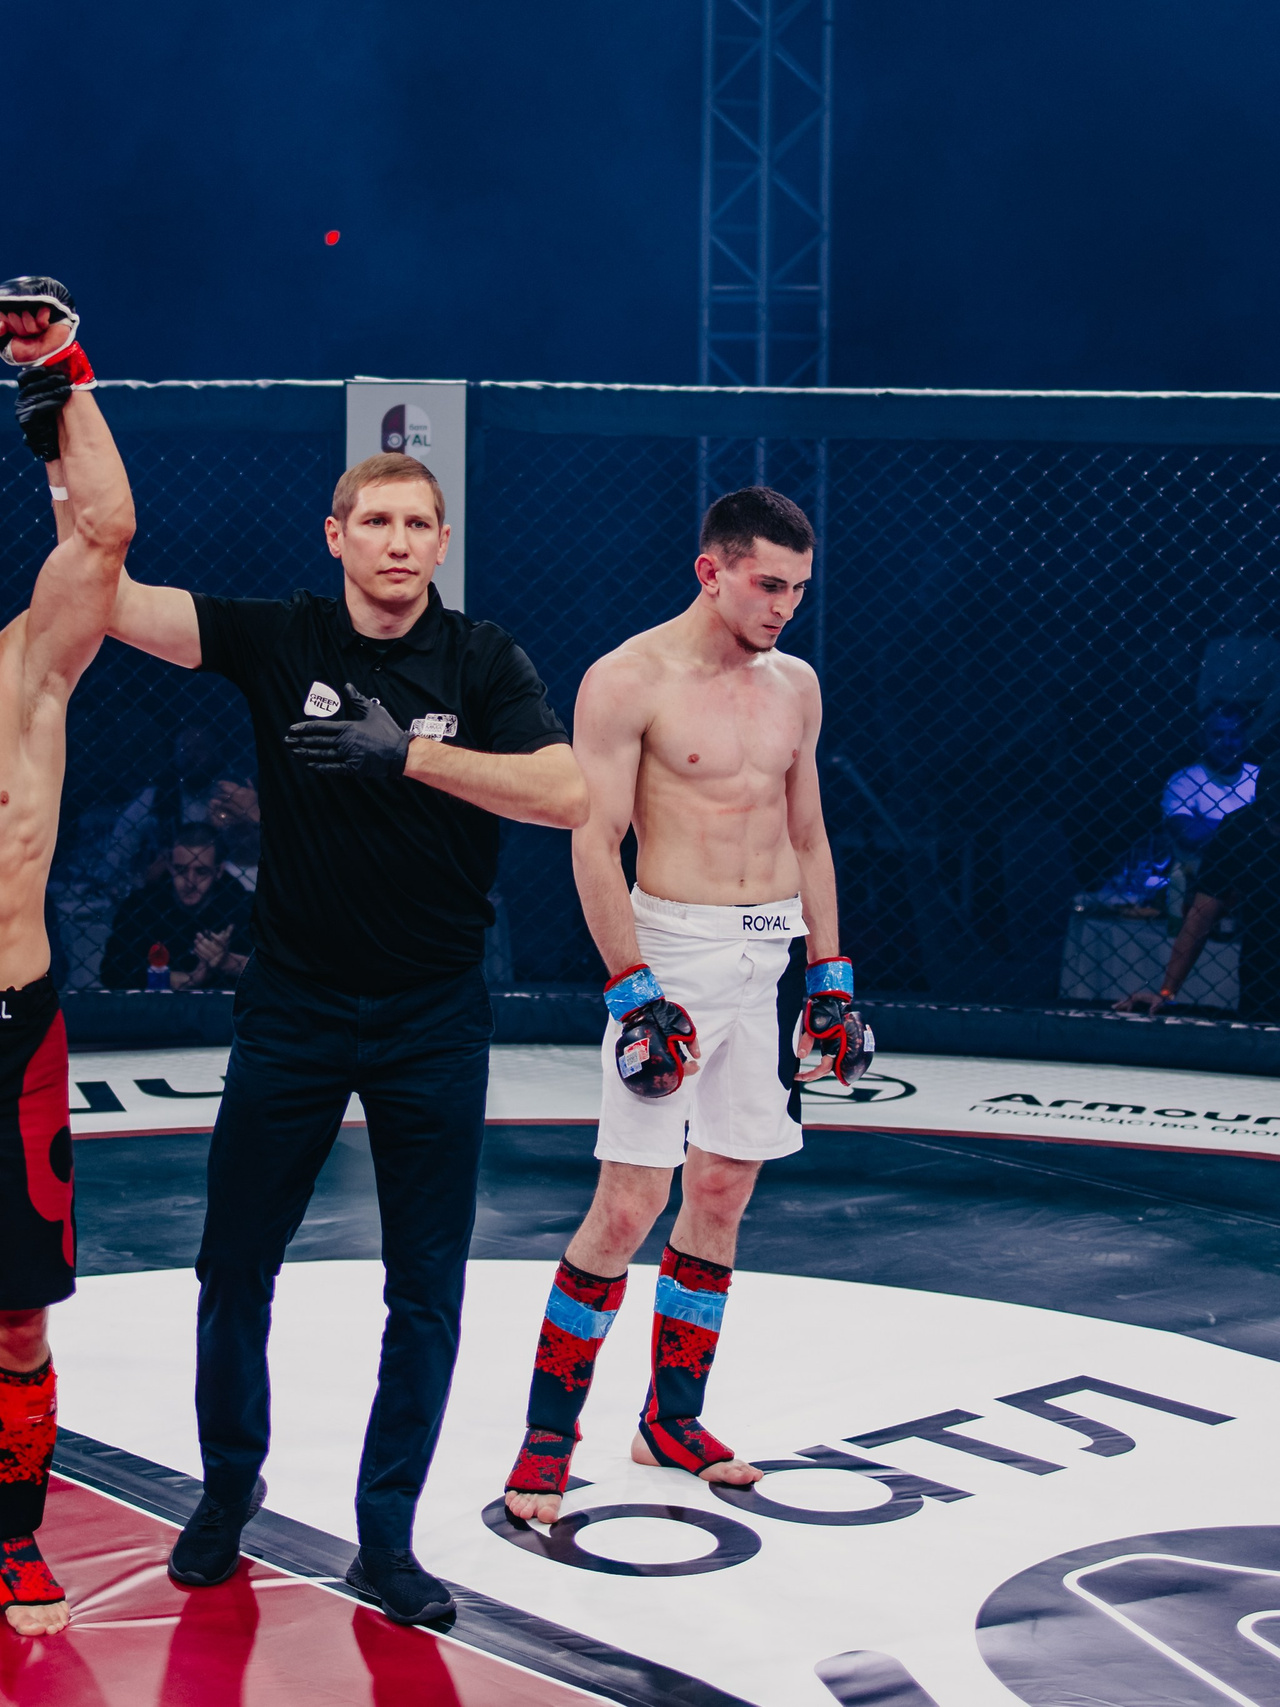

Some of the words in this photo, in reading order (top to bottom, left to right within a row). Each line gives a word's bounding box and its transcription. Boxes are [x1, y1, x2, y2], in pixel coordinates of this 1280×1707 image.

[388, 433, 431, 447] OYAL
[309, 693, 340, 708] GREEN
[309, 698, 333, 712] HILL
[742, 915, 791, 931] ROYAL
[969, 1104, 1199, 1131] Производство
[482, 1375, 1234, 1578] батл
